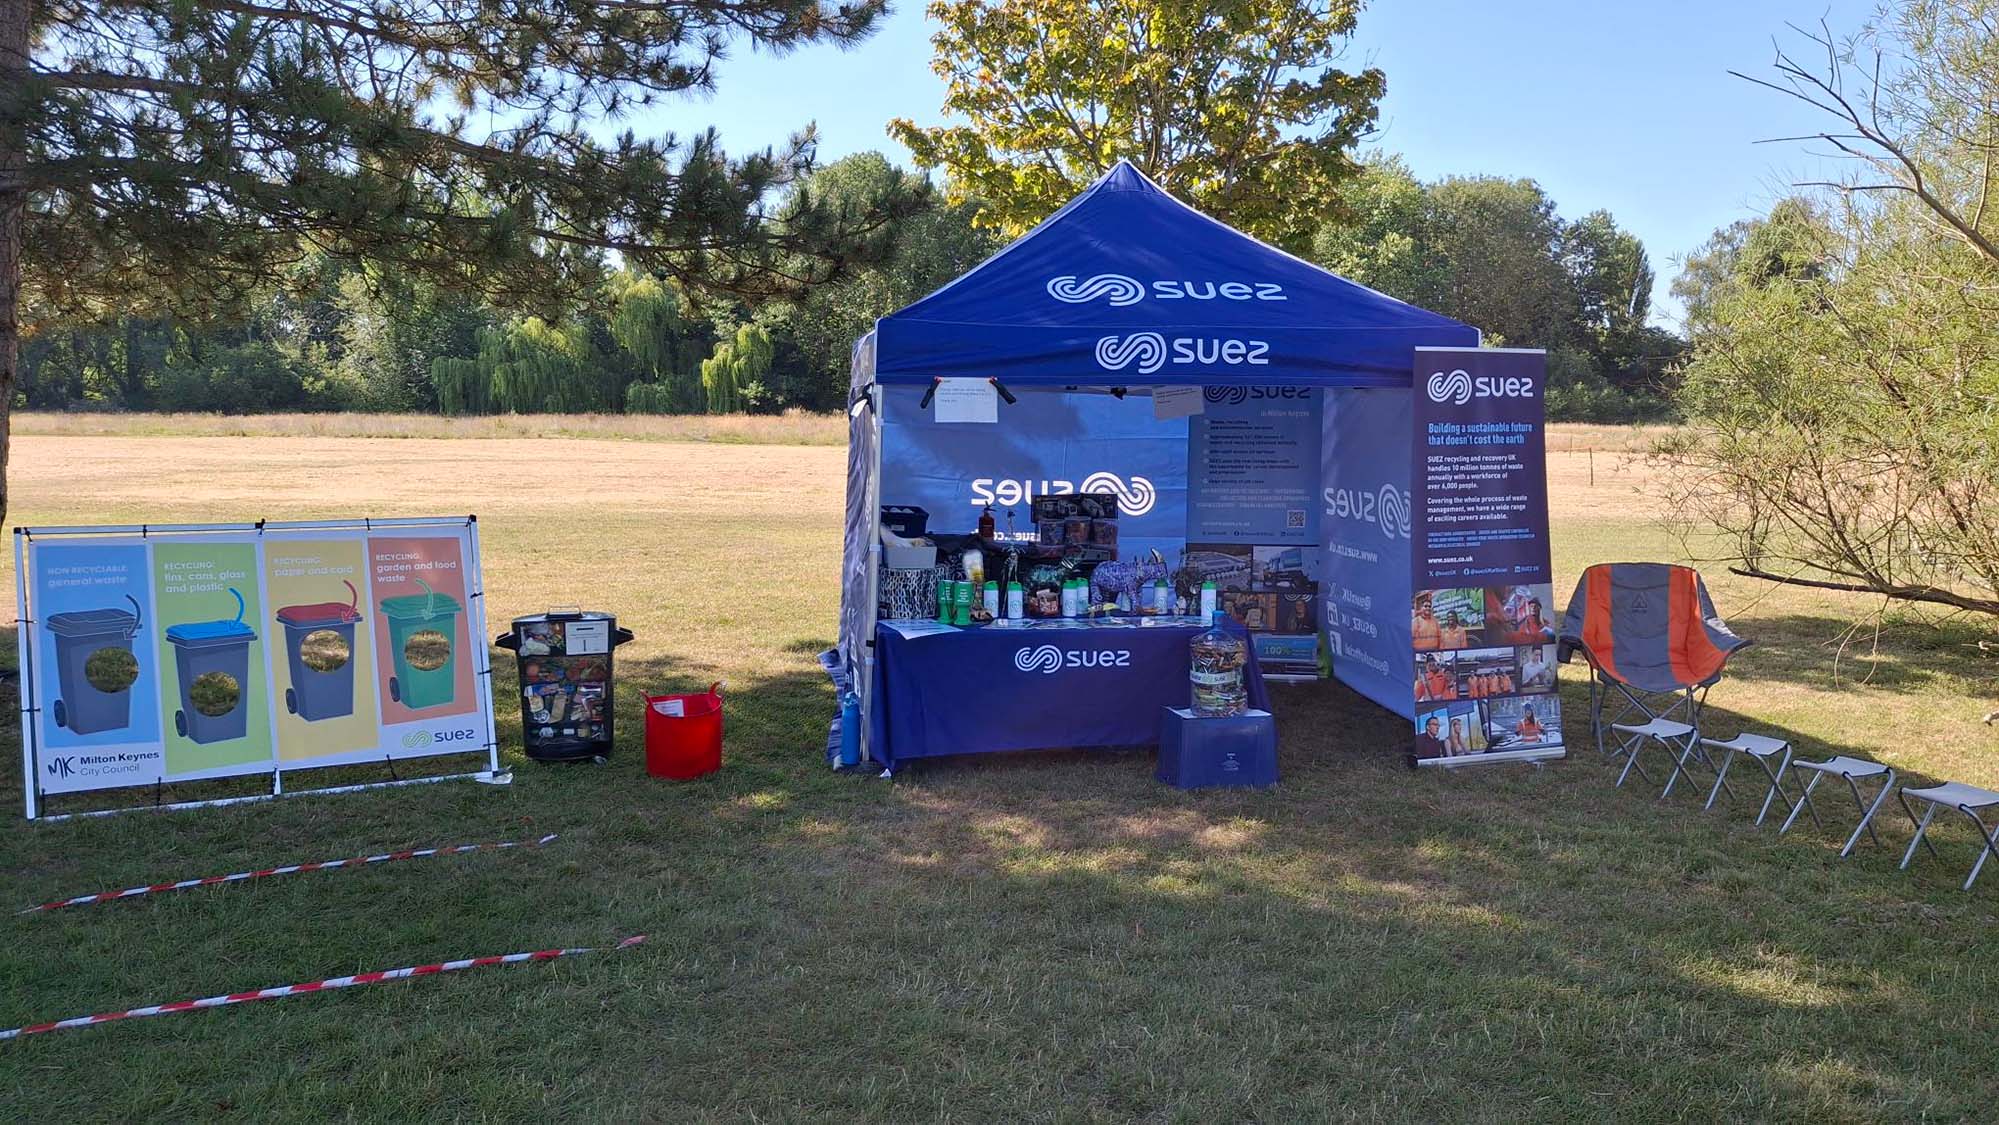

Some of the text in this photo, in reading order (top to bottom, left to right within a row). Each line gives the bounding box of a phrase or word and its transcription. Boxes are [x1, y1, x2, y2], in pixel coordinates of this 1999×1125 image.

[1152, 281, 1288, 300] suez
[1173, 338, 1269, 365] suez
[1251, 386, 1311, 399] suez
[1475, 377, 1534, 397] suez
[1428, 423, 1460, 435] Building
[1467, 422, 1510, 433] sustainable
[1511, 422, 1532, 432] future
[1428, 434, 1524, 445] that doesn't cost the earth
[1427, 497, 1452, 505] Covering
[308, 567, 328, 575] and
[376, 561, 456, 573] garden and food
[219, 569, 246, 580] glass
[377, 574, 405, 583] waste
[48, 575, 127, 588] general waste
[166, 582, 224, 594] and plastic
[1066, 650, 1130, 667] suez
[435, 729, 474, 742] suez
[80, 756, 116, 765] Milton
[118, 752, 159, 761] Keynes
[80, 764, 139, 776] City Council
